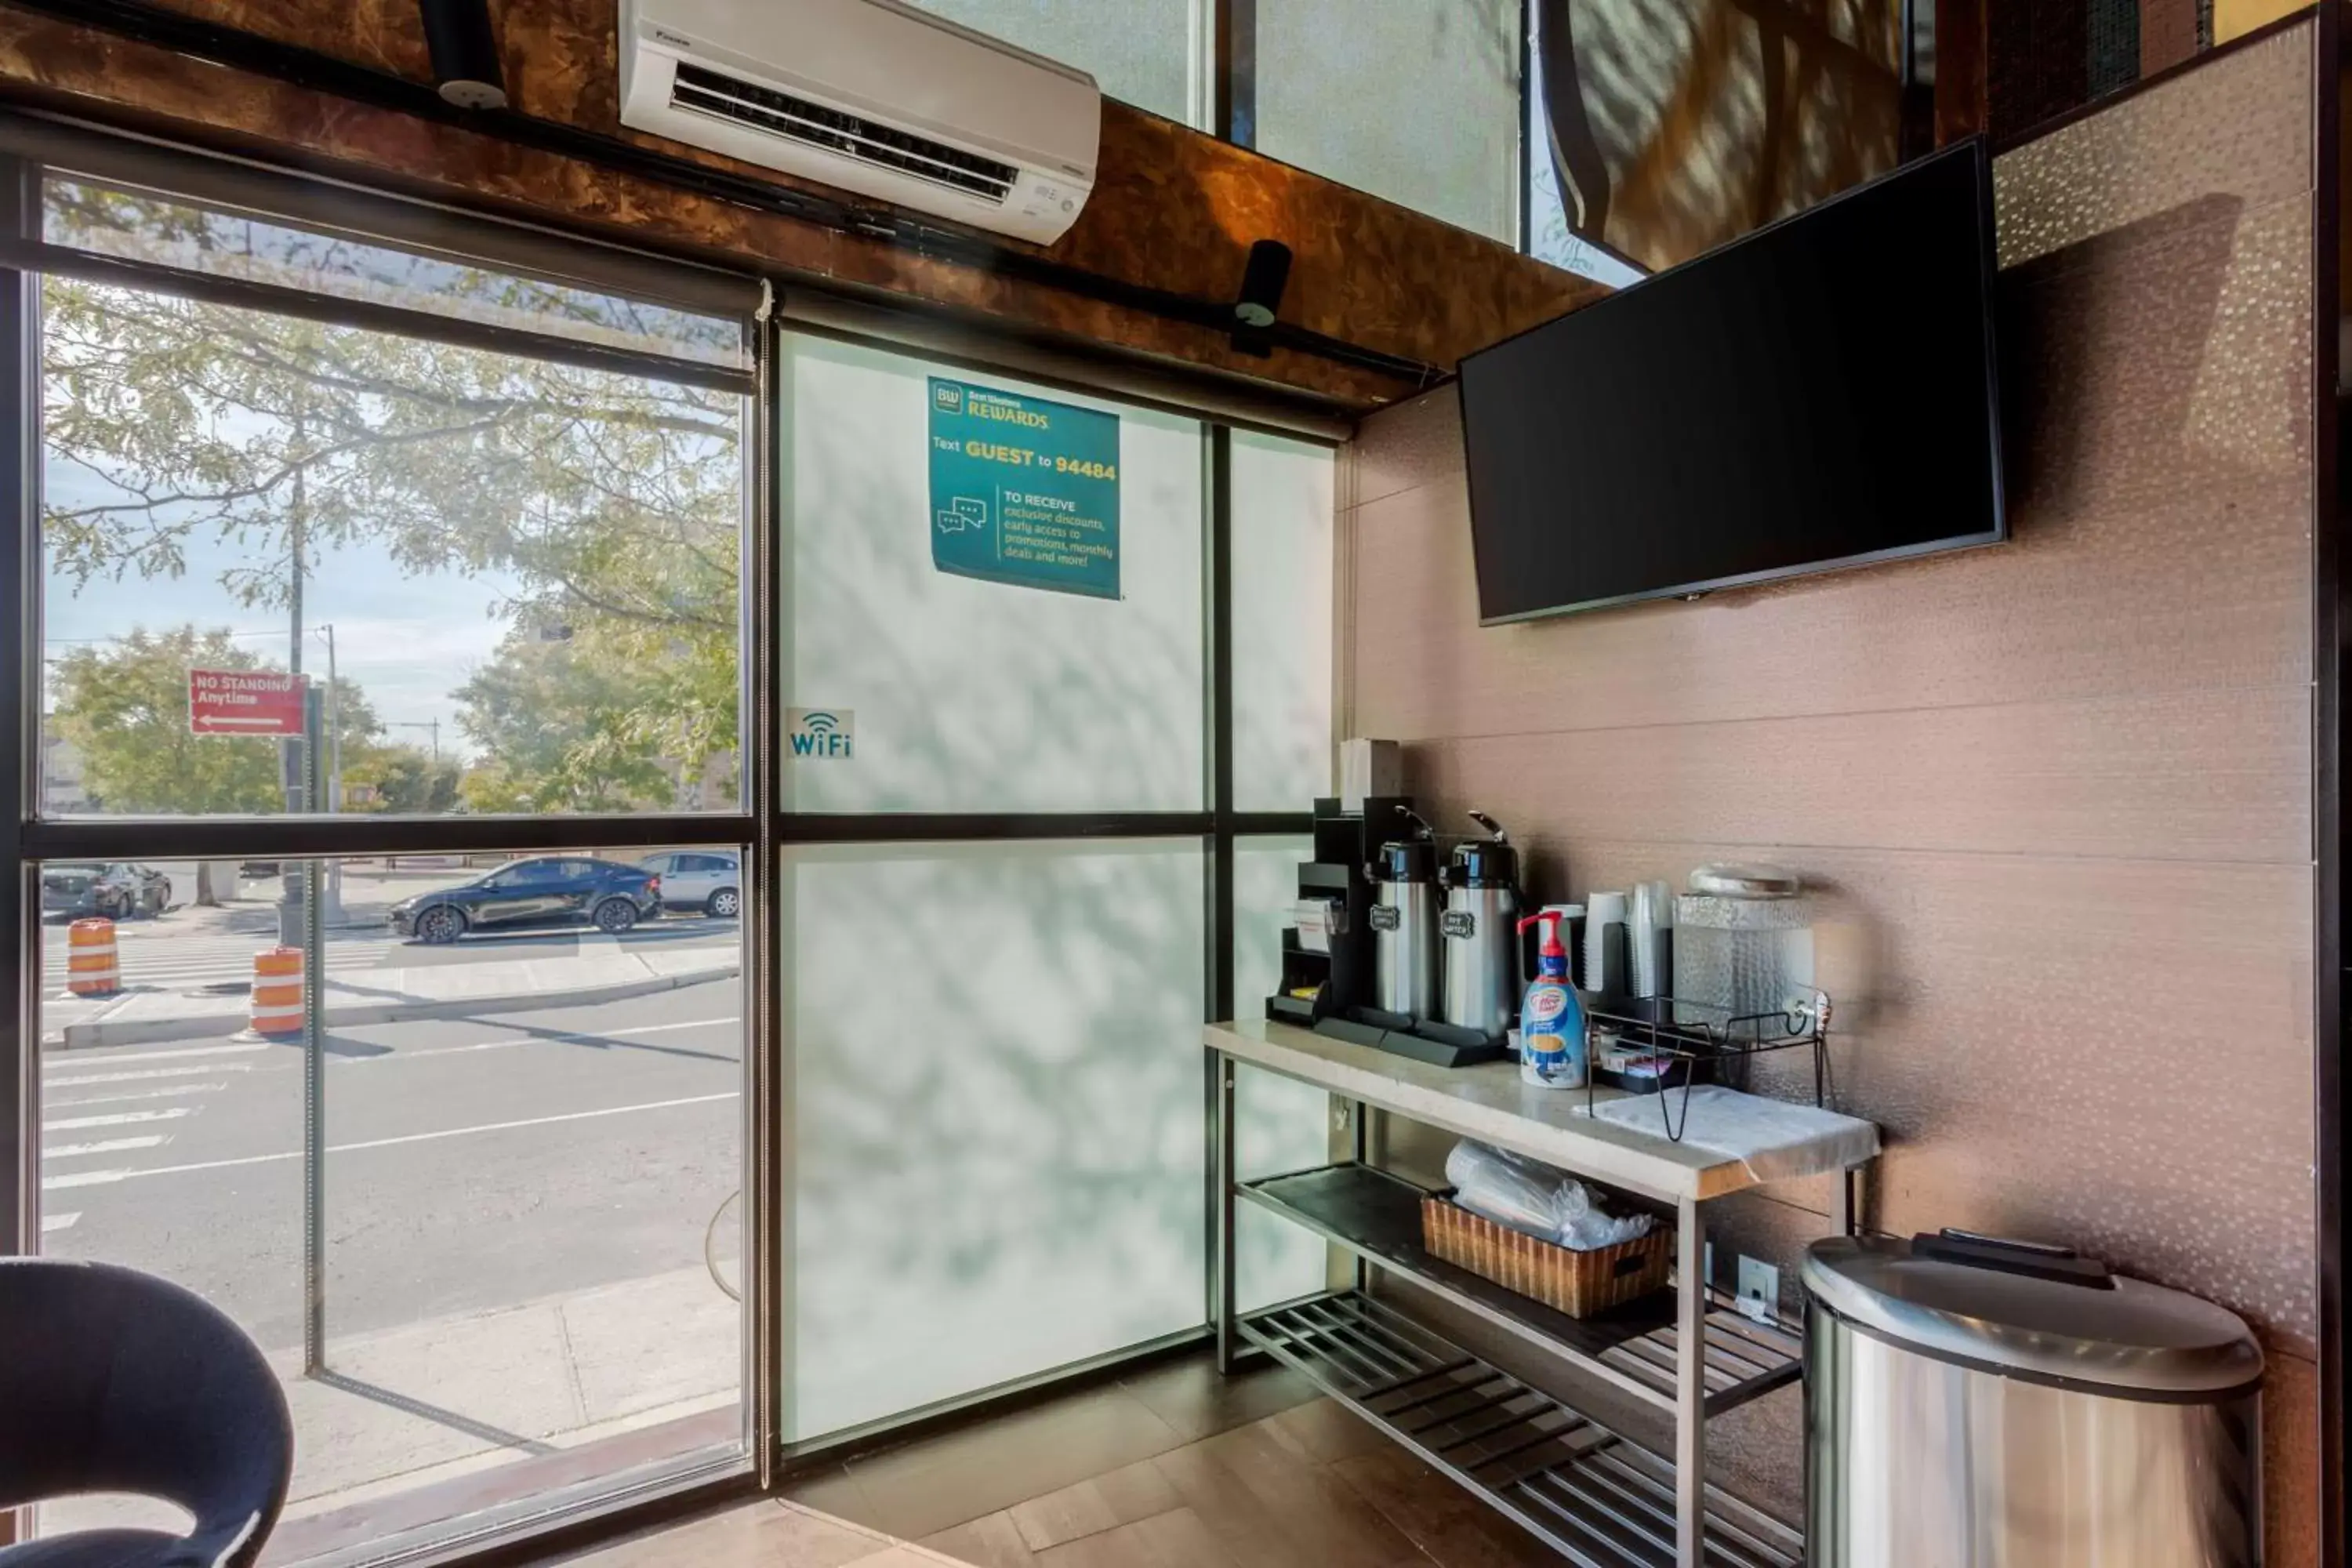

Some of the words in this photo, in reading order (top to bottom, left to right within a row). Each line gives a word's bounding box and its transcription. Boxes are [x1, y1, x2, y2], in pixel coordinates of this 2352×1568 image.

[968, 401, 1049, 429] REWARDS
[933, 436, 960, 452] Text
[965, 441, 1034, 466] GUEST
[1038, 456, 1052, 467] to
[1055, 456, 1116, 481] 94484
[1004, 490, 1022, 503] TO
[1025, 495, 1076, 512] RECEIVE
[1004, 506, 1052, 521] exclusive
[1004, 519, 1033, 535] early
[1034, 524, 1067, 538] access
[1069, 529, 1080, 539] to
[1004, 545, 1033, 559] deals
[1035, 550, 1055, 562] and
[1069, 543, 1113, 561] monthly
[198, 676, 217, 689] NO
[198, 691, 258, 706] Anytime
